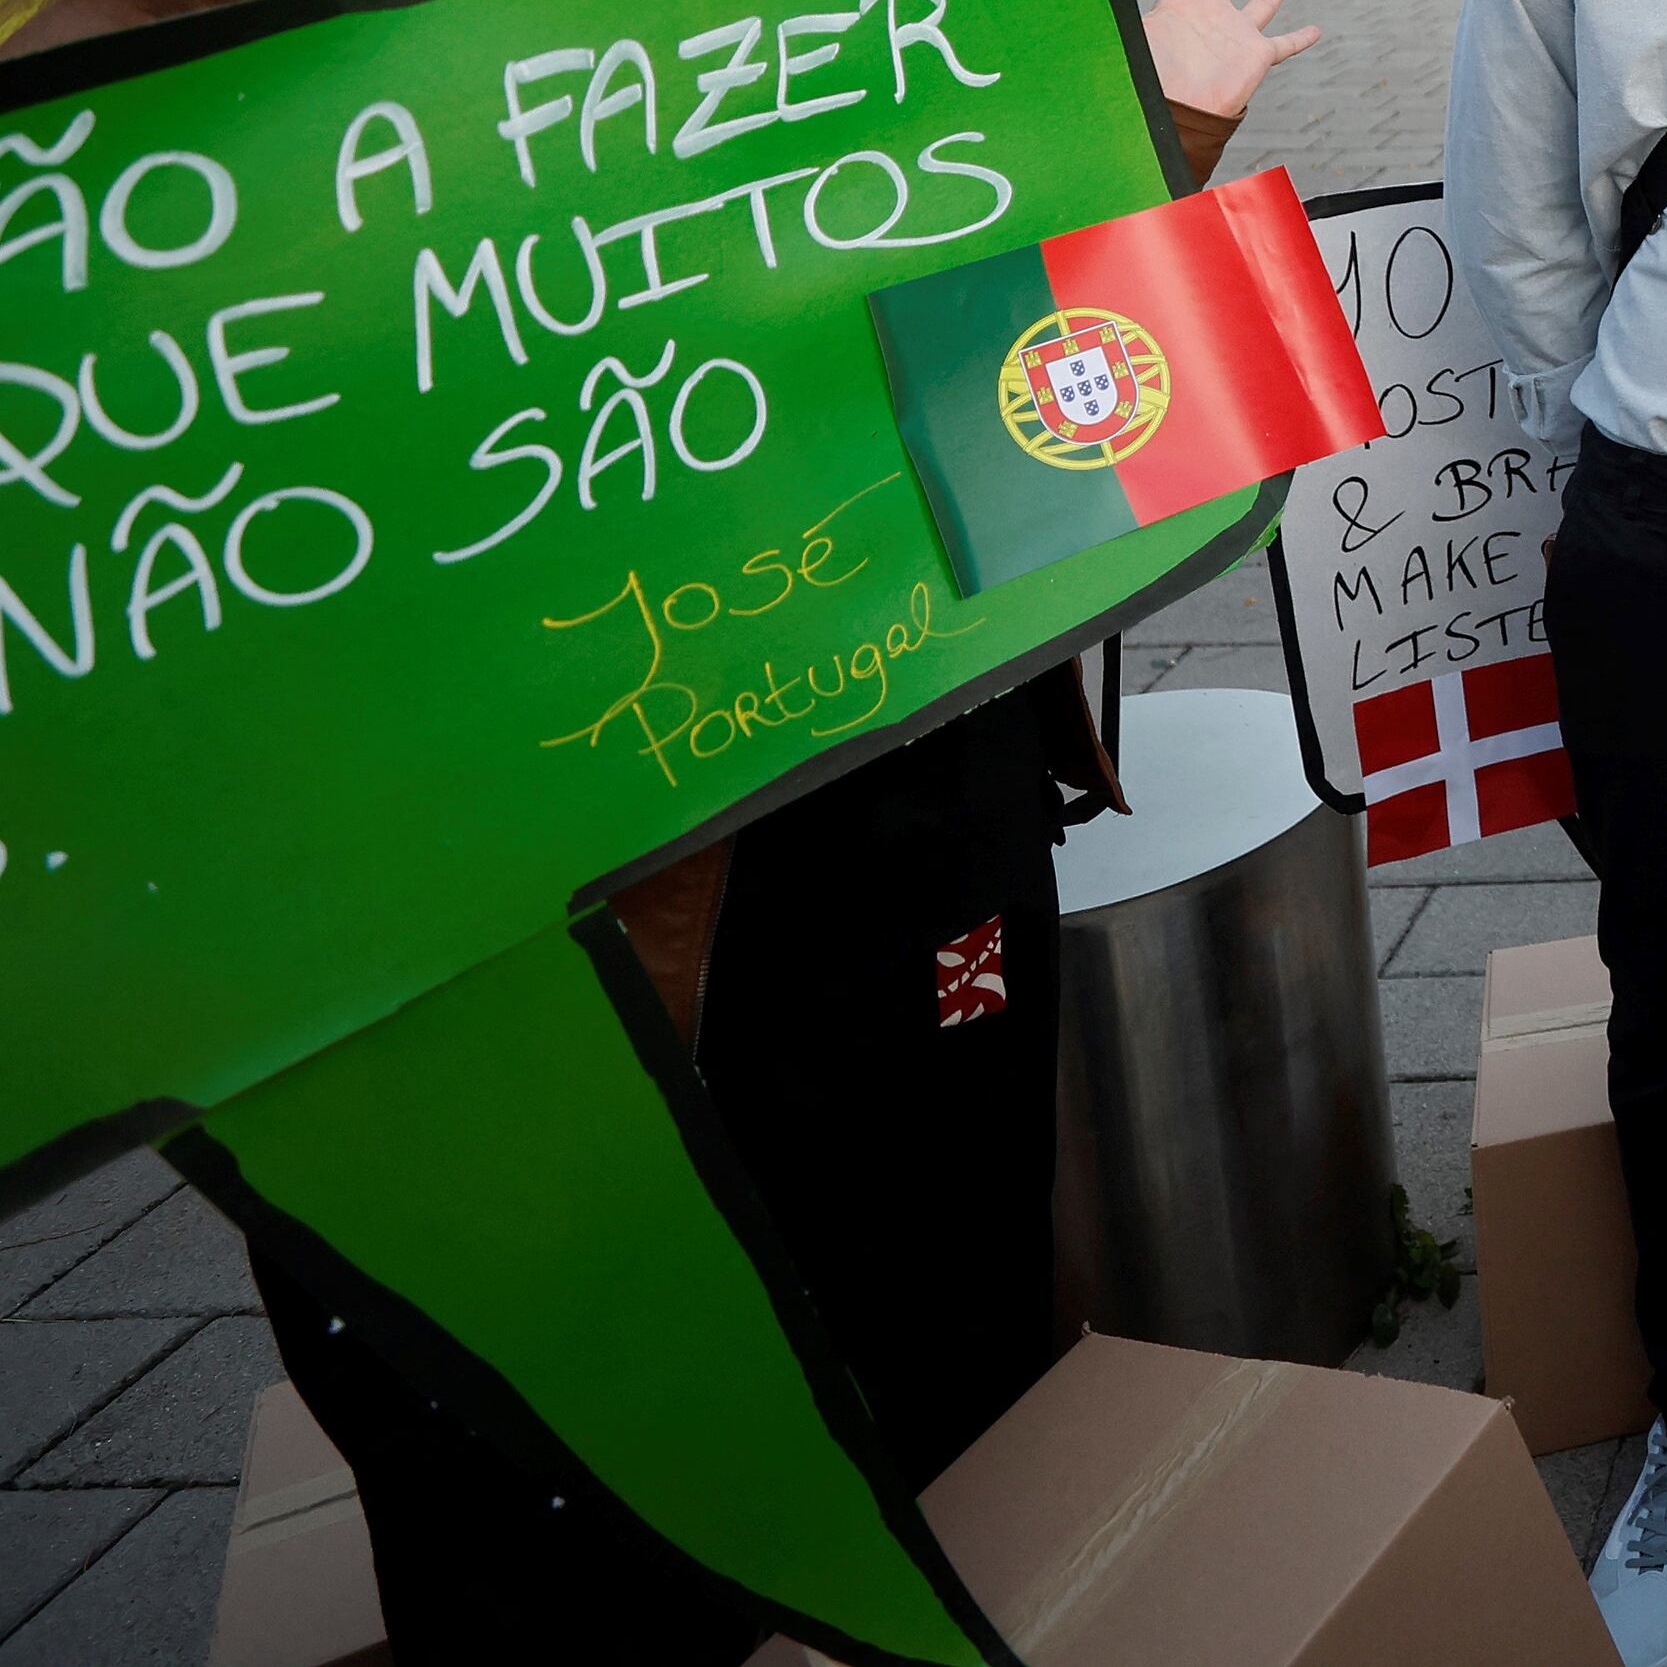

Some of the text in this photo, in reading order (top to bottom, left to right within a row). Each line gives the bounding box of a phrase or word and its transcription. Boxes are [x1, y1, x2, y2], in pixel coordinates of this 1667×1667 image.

[335, 100, 433, 232] A
[0, 131, 1013, 509] QUE MUITOS
[1364, 358, 1504, 450] OST
[0, 338, 768, 715] NÃO SÃO
[1333, 531, 1522, 632] MAKE
